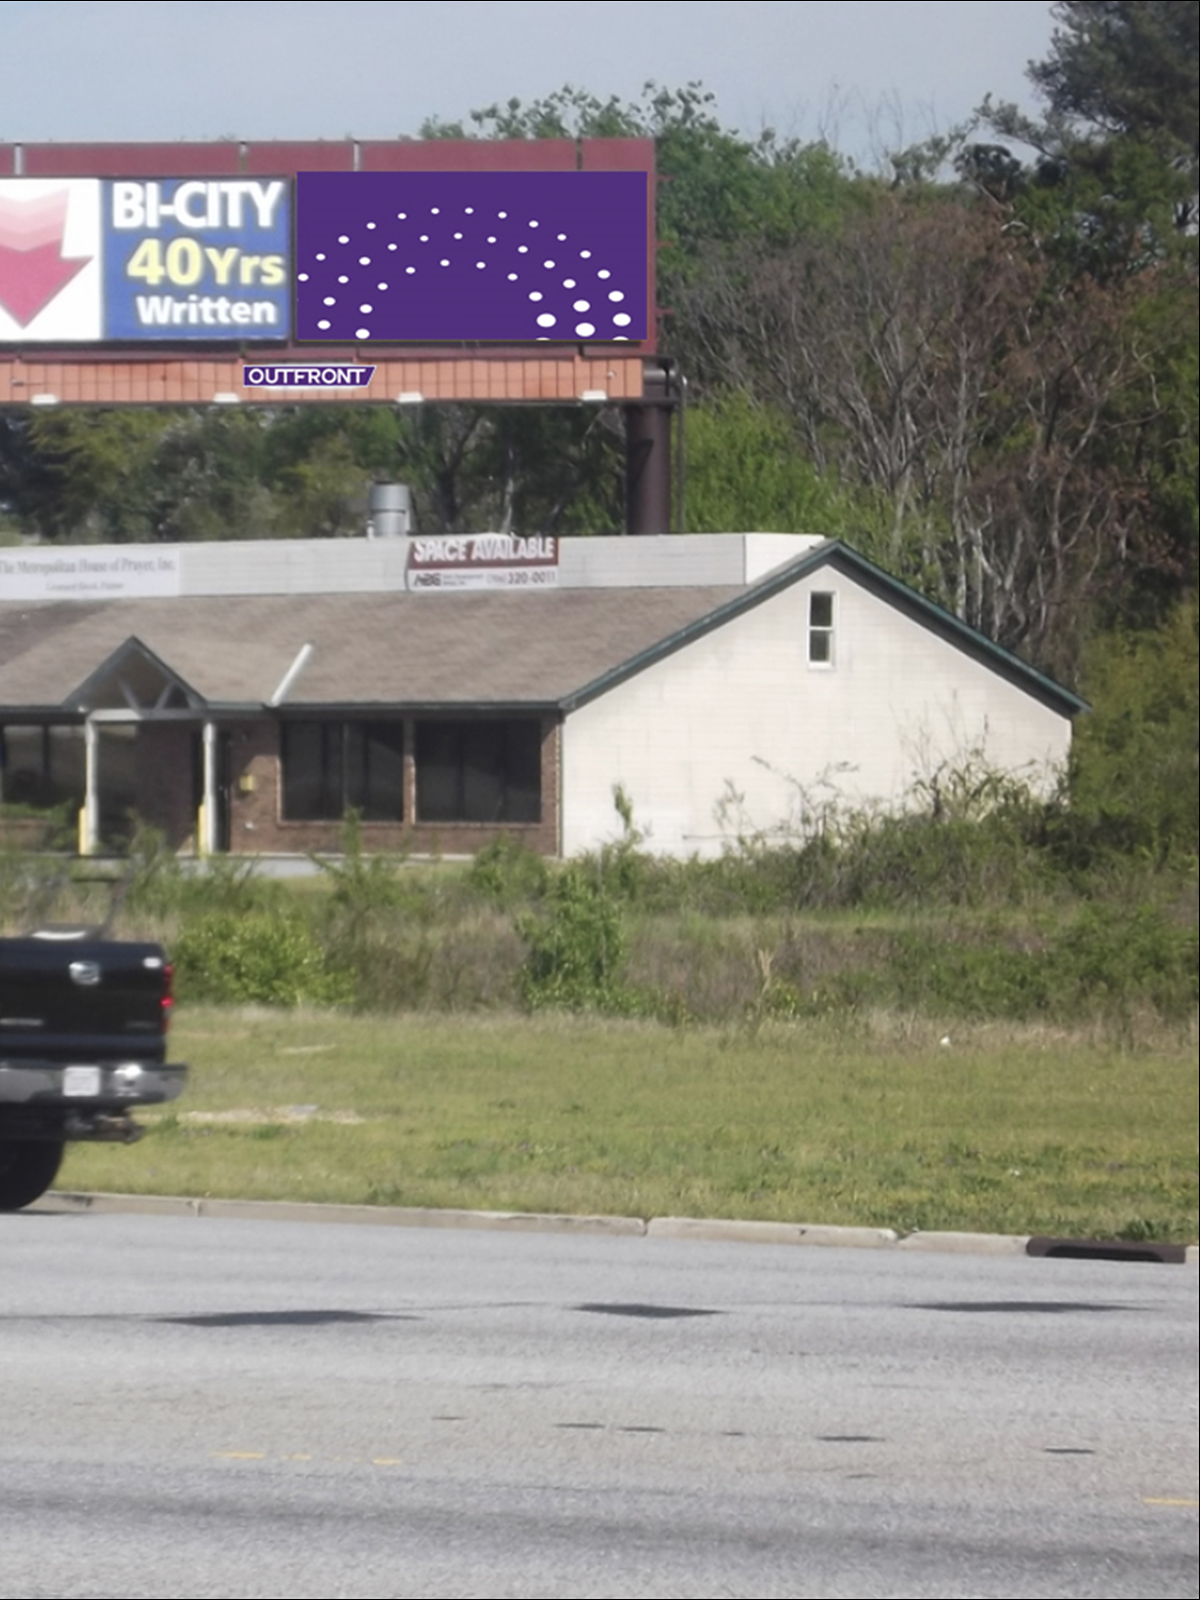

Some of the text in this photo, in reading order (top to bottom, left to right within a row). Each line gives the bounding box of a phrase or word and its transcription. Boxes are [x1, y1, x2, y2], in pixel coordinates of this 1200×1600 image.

[113, 181, 283, 229] BI-CITY
[136, 294, 277, 325] Written
[248, 368, 366, 384] OUTFRONT
[413, 536, 555, 562] SPACE AVAILABLE
[18, 558, 76, 576] Metropolitan
[79, 558, 107, 573] House
[110, 558, 120, 572] of
